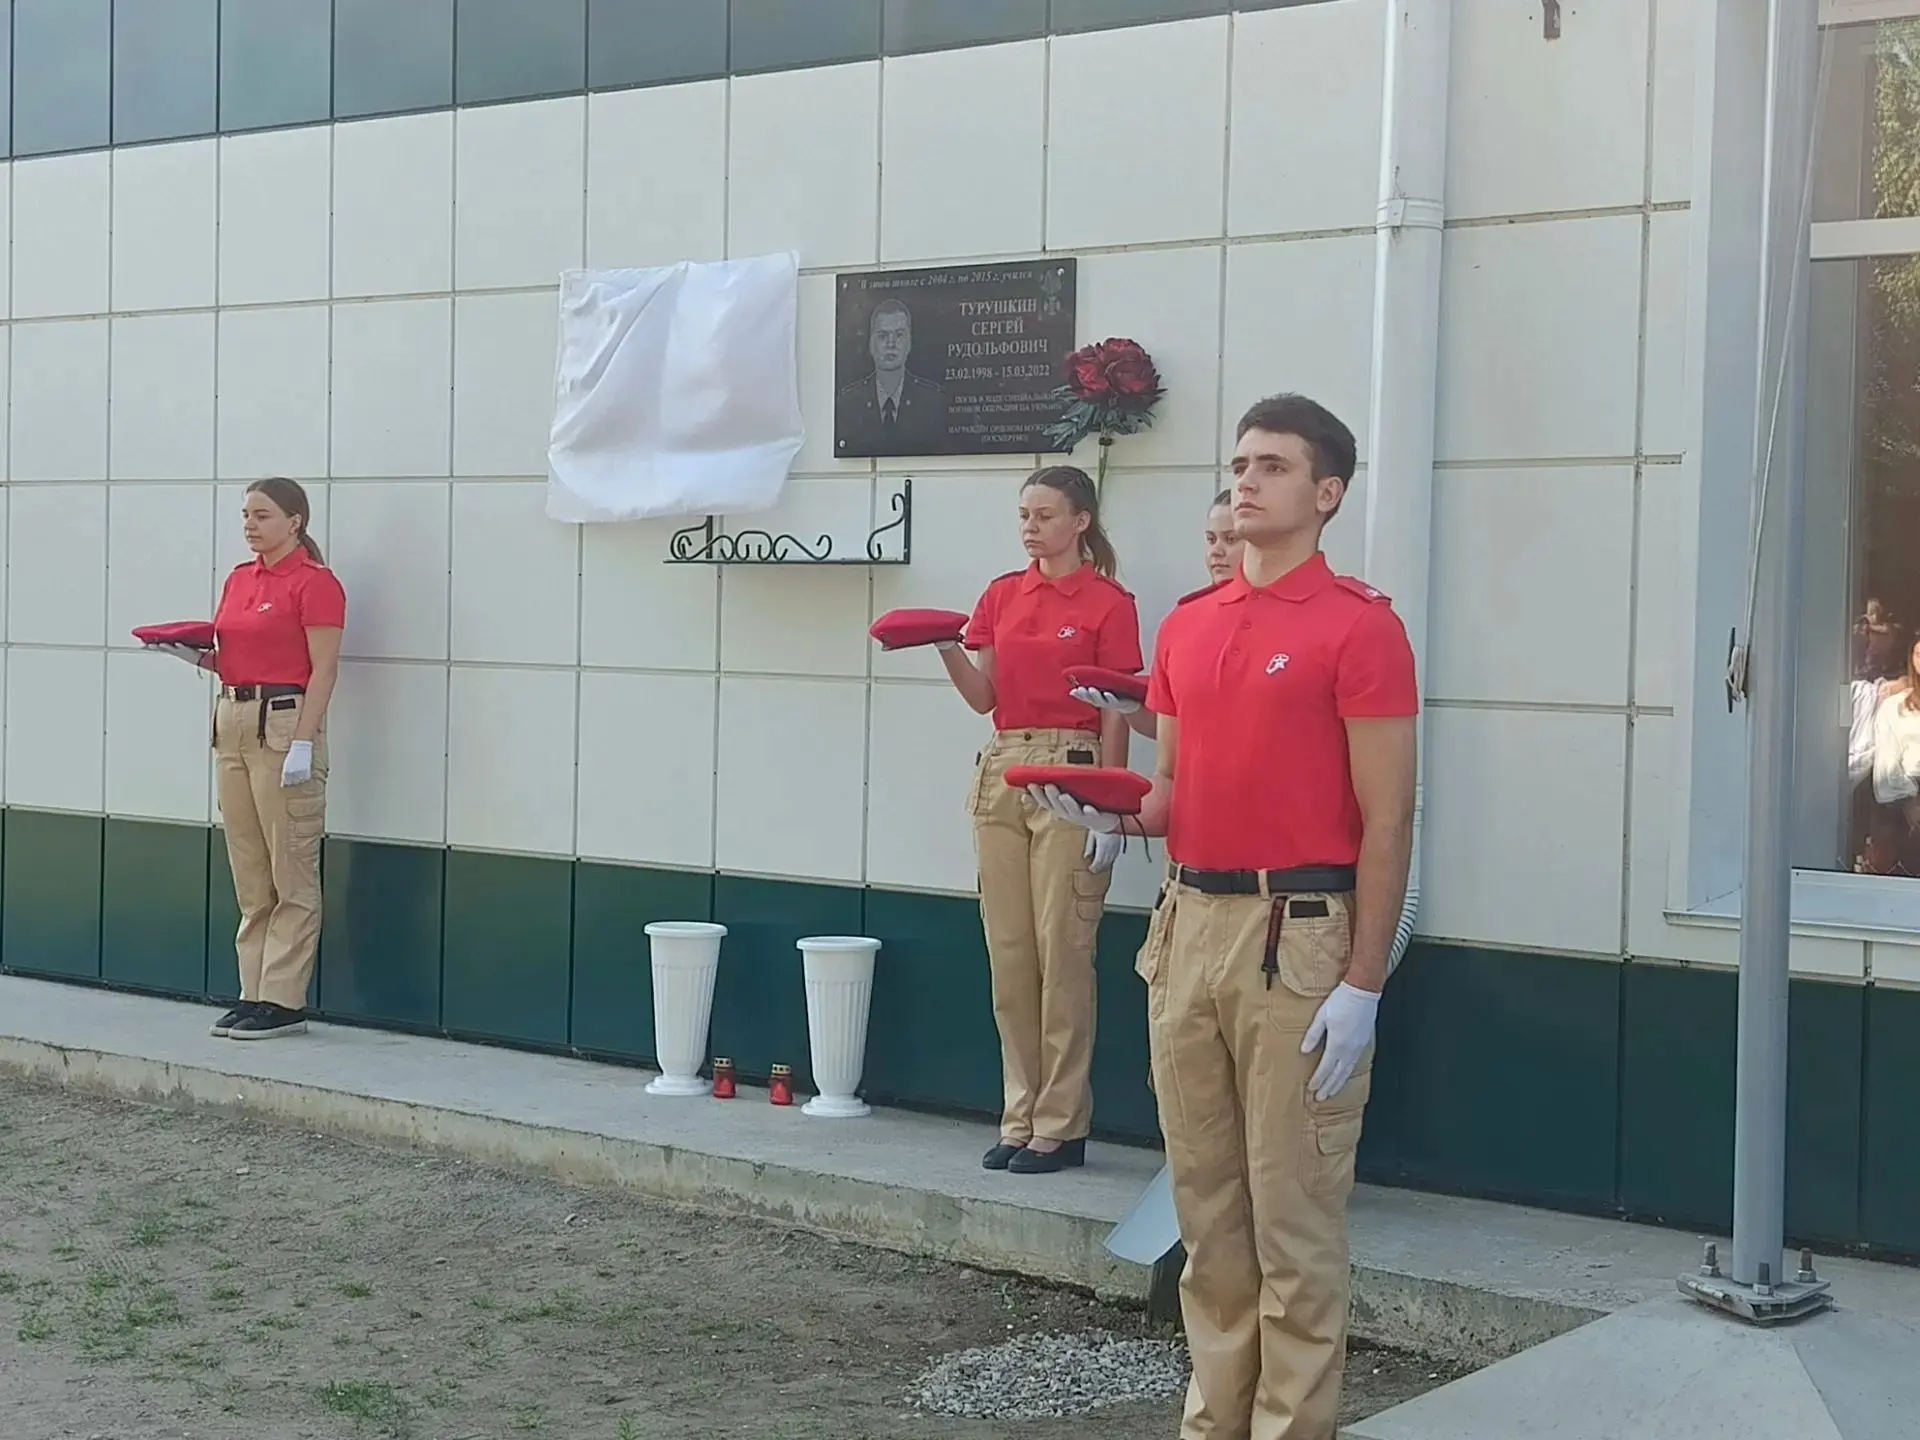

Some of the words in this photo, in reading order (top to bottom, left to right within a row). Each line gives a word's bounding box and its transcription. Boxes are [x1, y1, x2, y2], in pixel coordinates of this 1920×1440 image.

[928, 274, 948, 287] 2004
[958, 275, 969, 285] по
[971, 271, 992, 283] 2015
[959, 298, 1037, 316] ТУРУШКИН
[971, 316, 1024, 336] СЕРГЕЙ
[947, 338, 1048, 359] РУДОЛЬФОВИЧ
[945, 367, 993, 380] 23.02.1998
[1002, 364, 1050, 379] 15.03.2022
